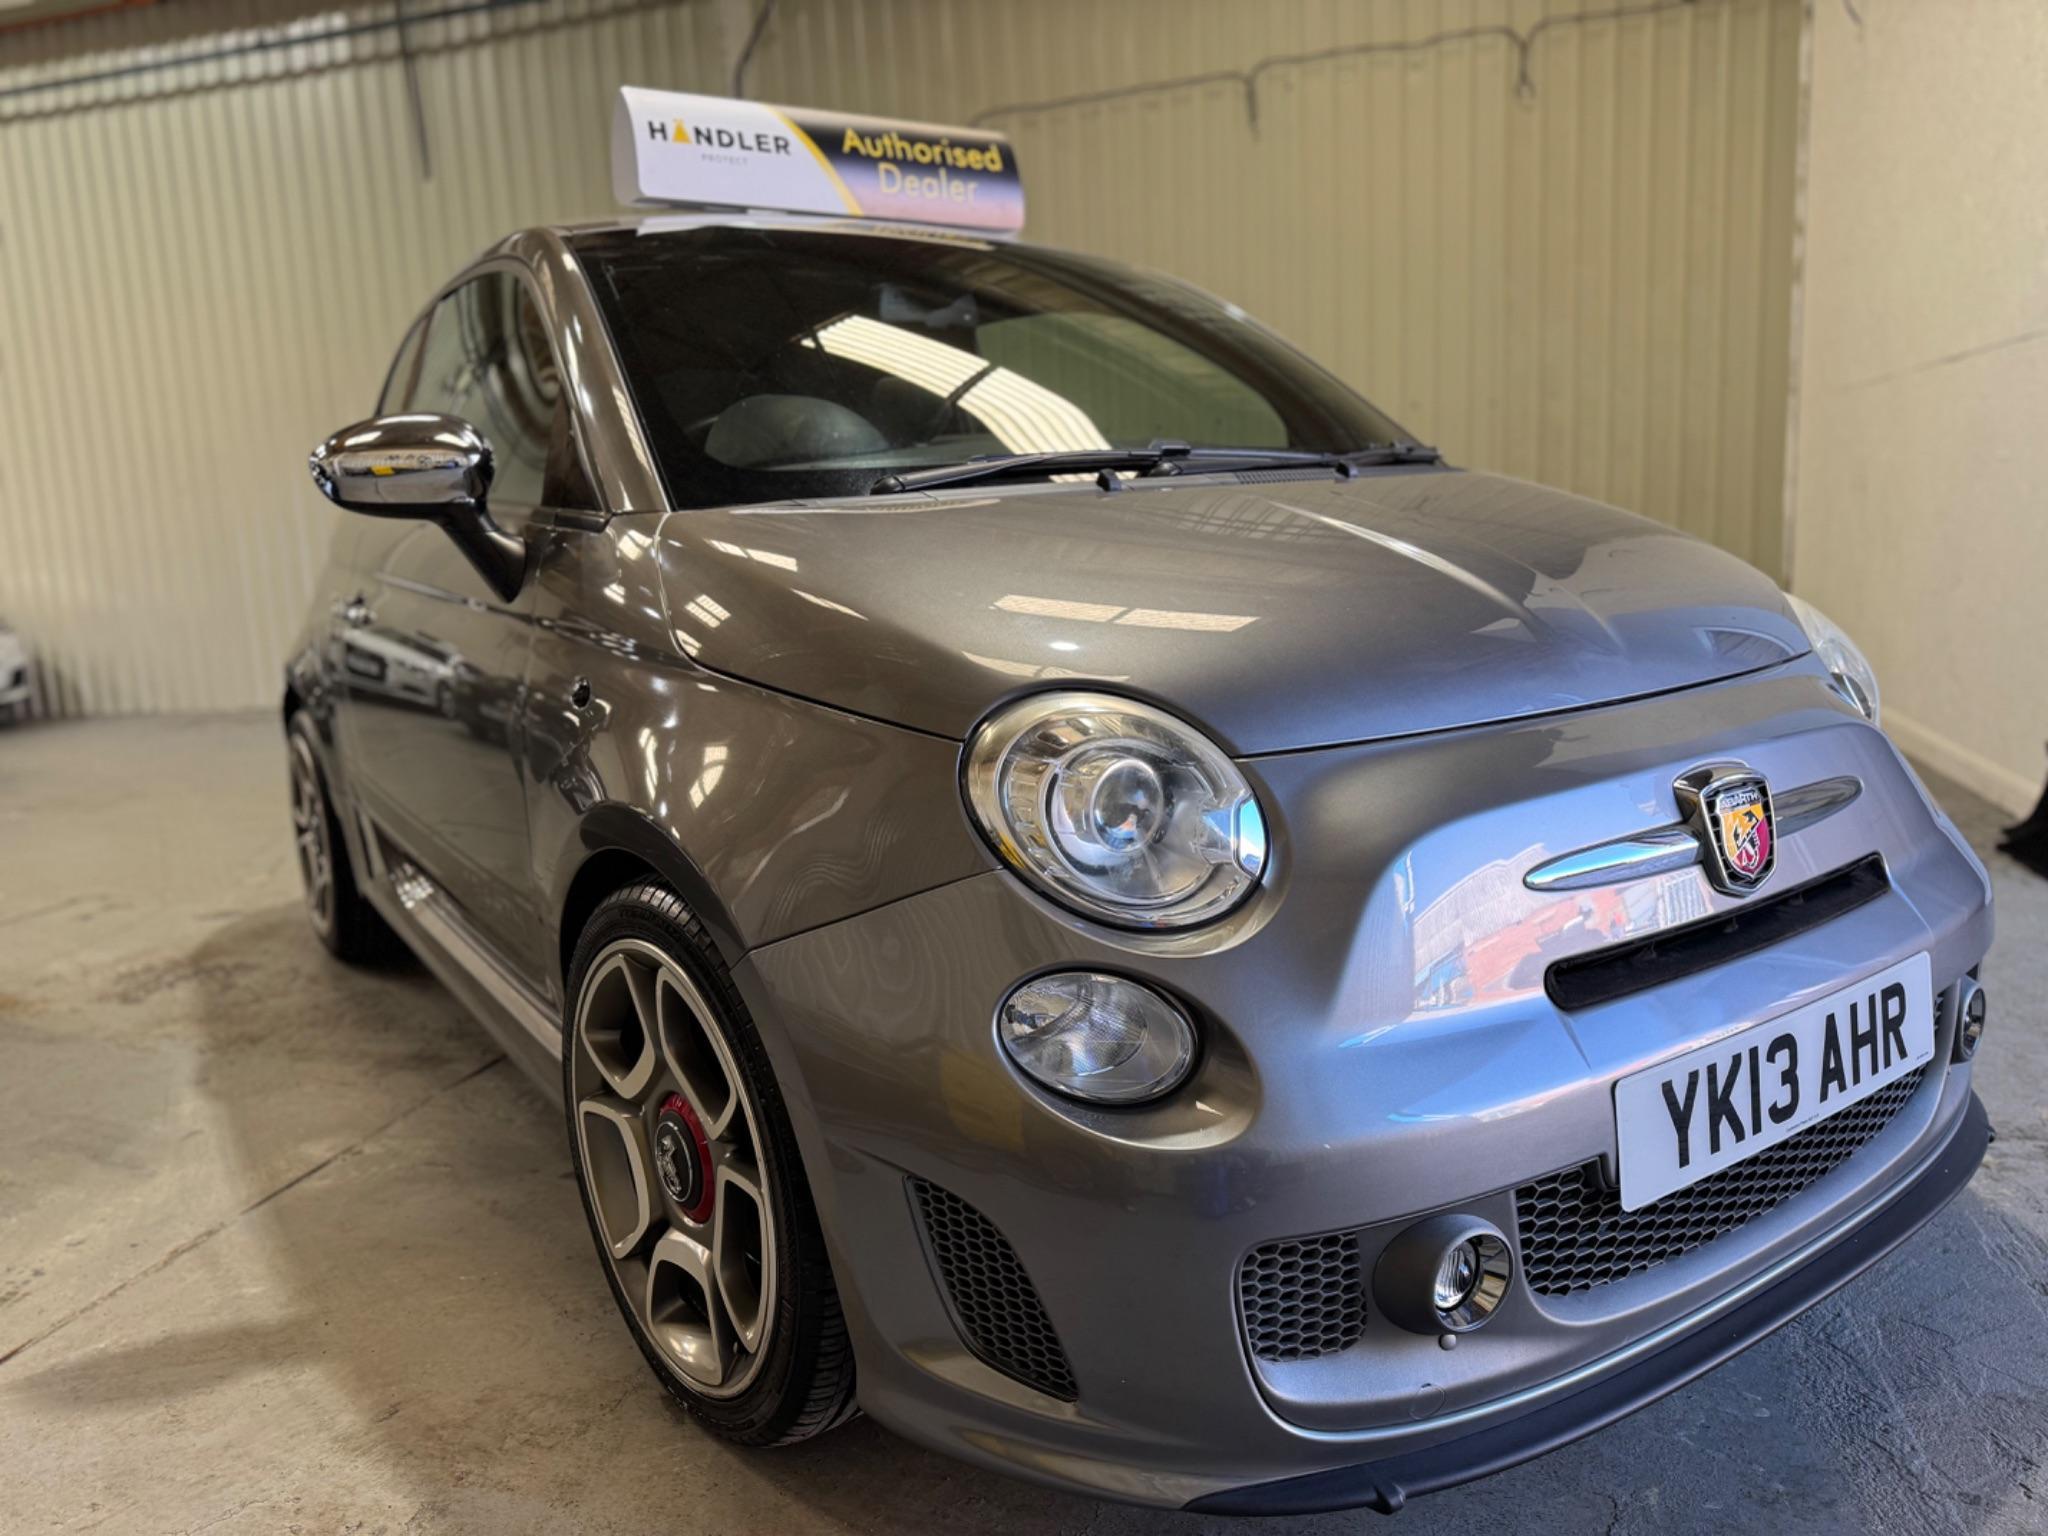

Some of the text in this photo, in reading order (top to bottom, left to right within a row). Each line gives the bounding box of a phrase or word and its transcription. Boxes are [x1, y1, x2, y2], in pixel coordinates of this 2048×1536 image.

[842, 128, 1003, 172] Authorised
[879, 163, 979, 202] Dealer
[1661, 981, 1908, 1169] YK13 AHR
